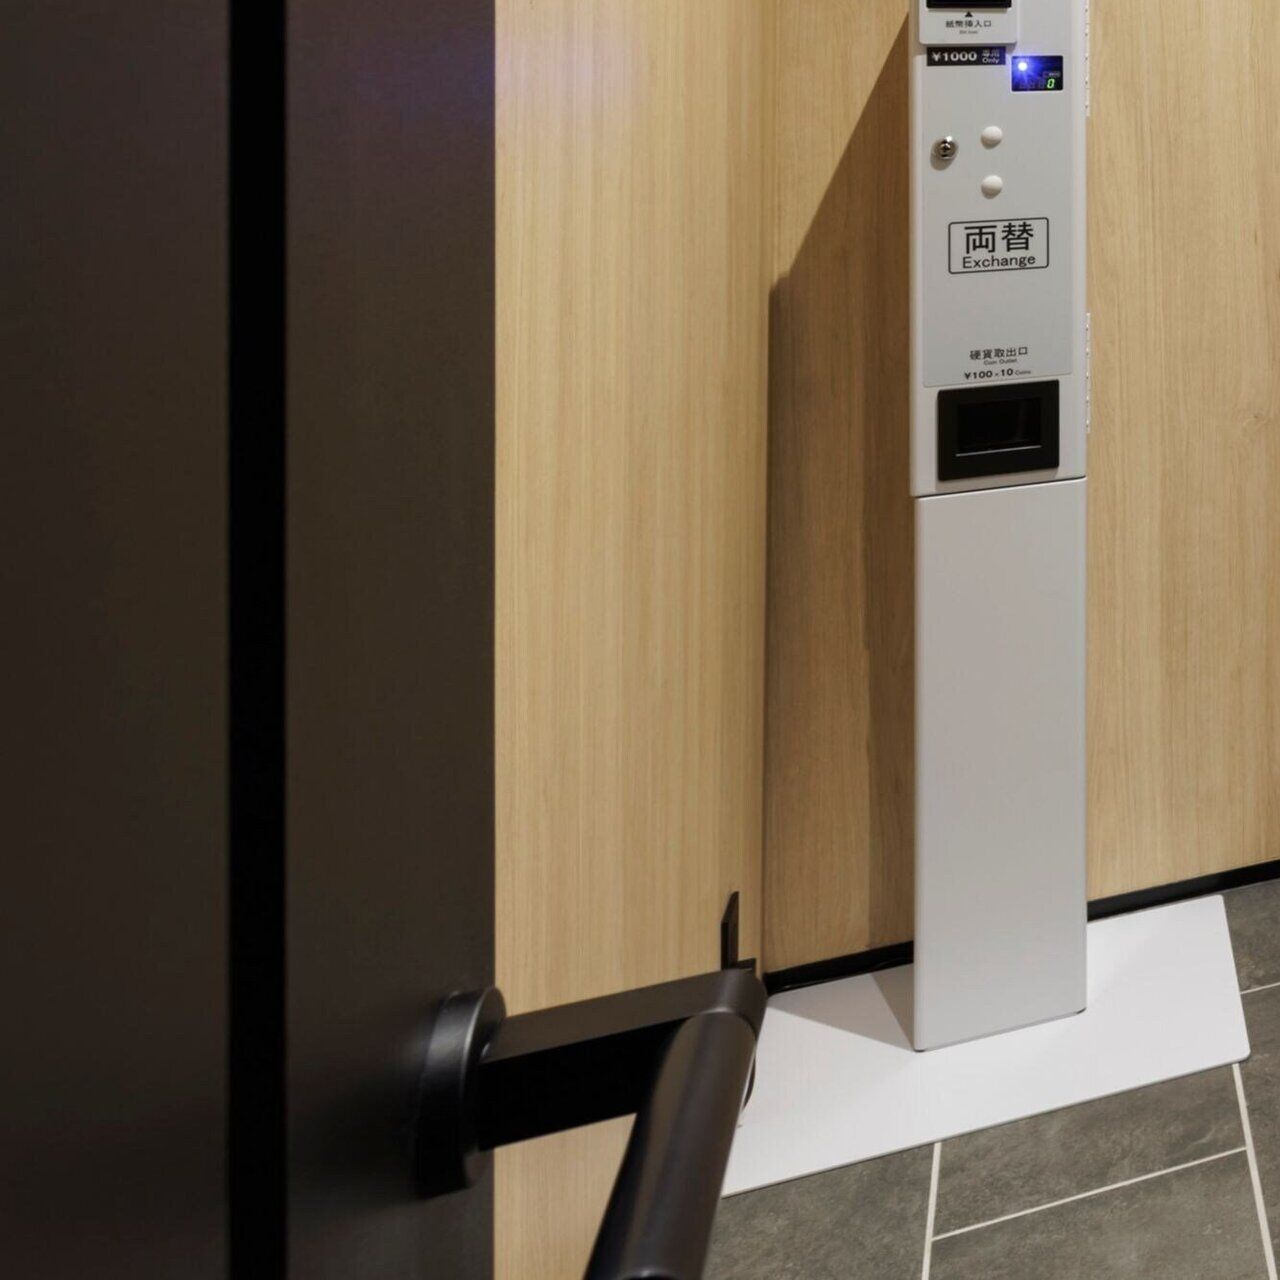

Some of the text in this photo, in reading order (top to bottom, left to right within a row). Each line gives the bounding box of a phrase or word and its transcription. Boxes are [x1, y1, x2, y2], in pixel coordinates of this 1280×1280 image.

[932, 51, 978, 62] ¥1000
[964, 221, 1034, 255] 両替
[962, 254, 1036, 269] Exchange
[969, 346, 1028, 361] 硬貨取出口
